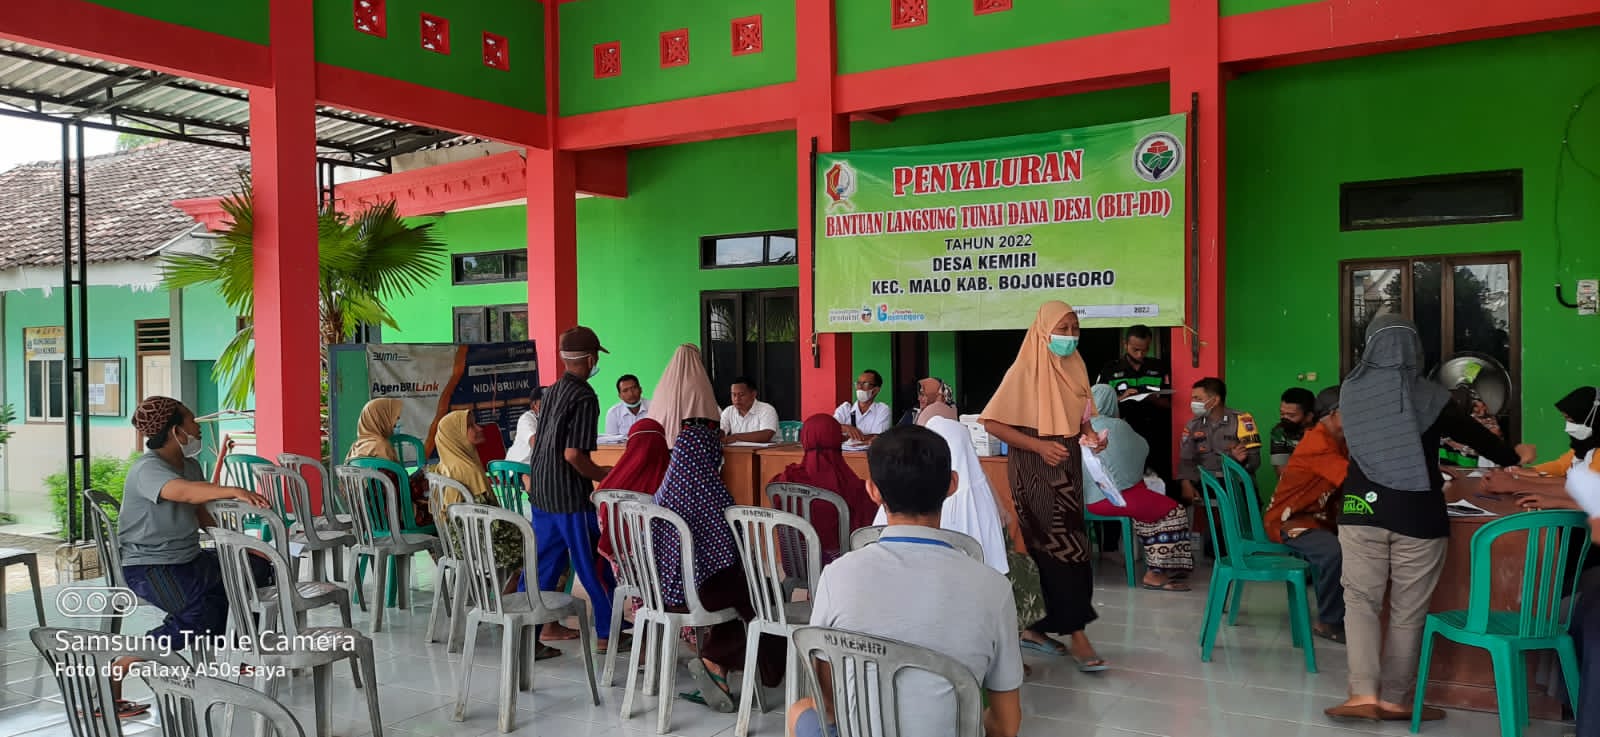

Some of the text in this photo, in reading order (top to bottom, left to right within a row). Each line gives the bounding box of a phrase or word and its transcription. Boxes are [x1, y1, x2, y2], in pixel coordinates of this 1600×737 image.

[893, 150, 1083, 195] PENYALURAN
[826, 190, 1171, 237] BANTUAN LANGSUNG TUNAI DANA DESA (BLT-DD)
[945, 234, 1032, 251] TAHUN 2022
[933, 252, 1036, 272] DESA KEMIRI
[872, 270, 1114, 294] KEC. MALO KAB. BOJONEGORO
